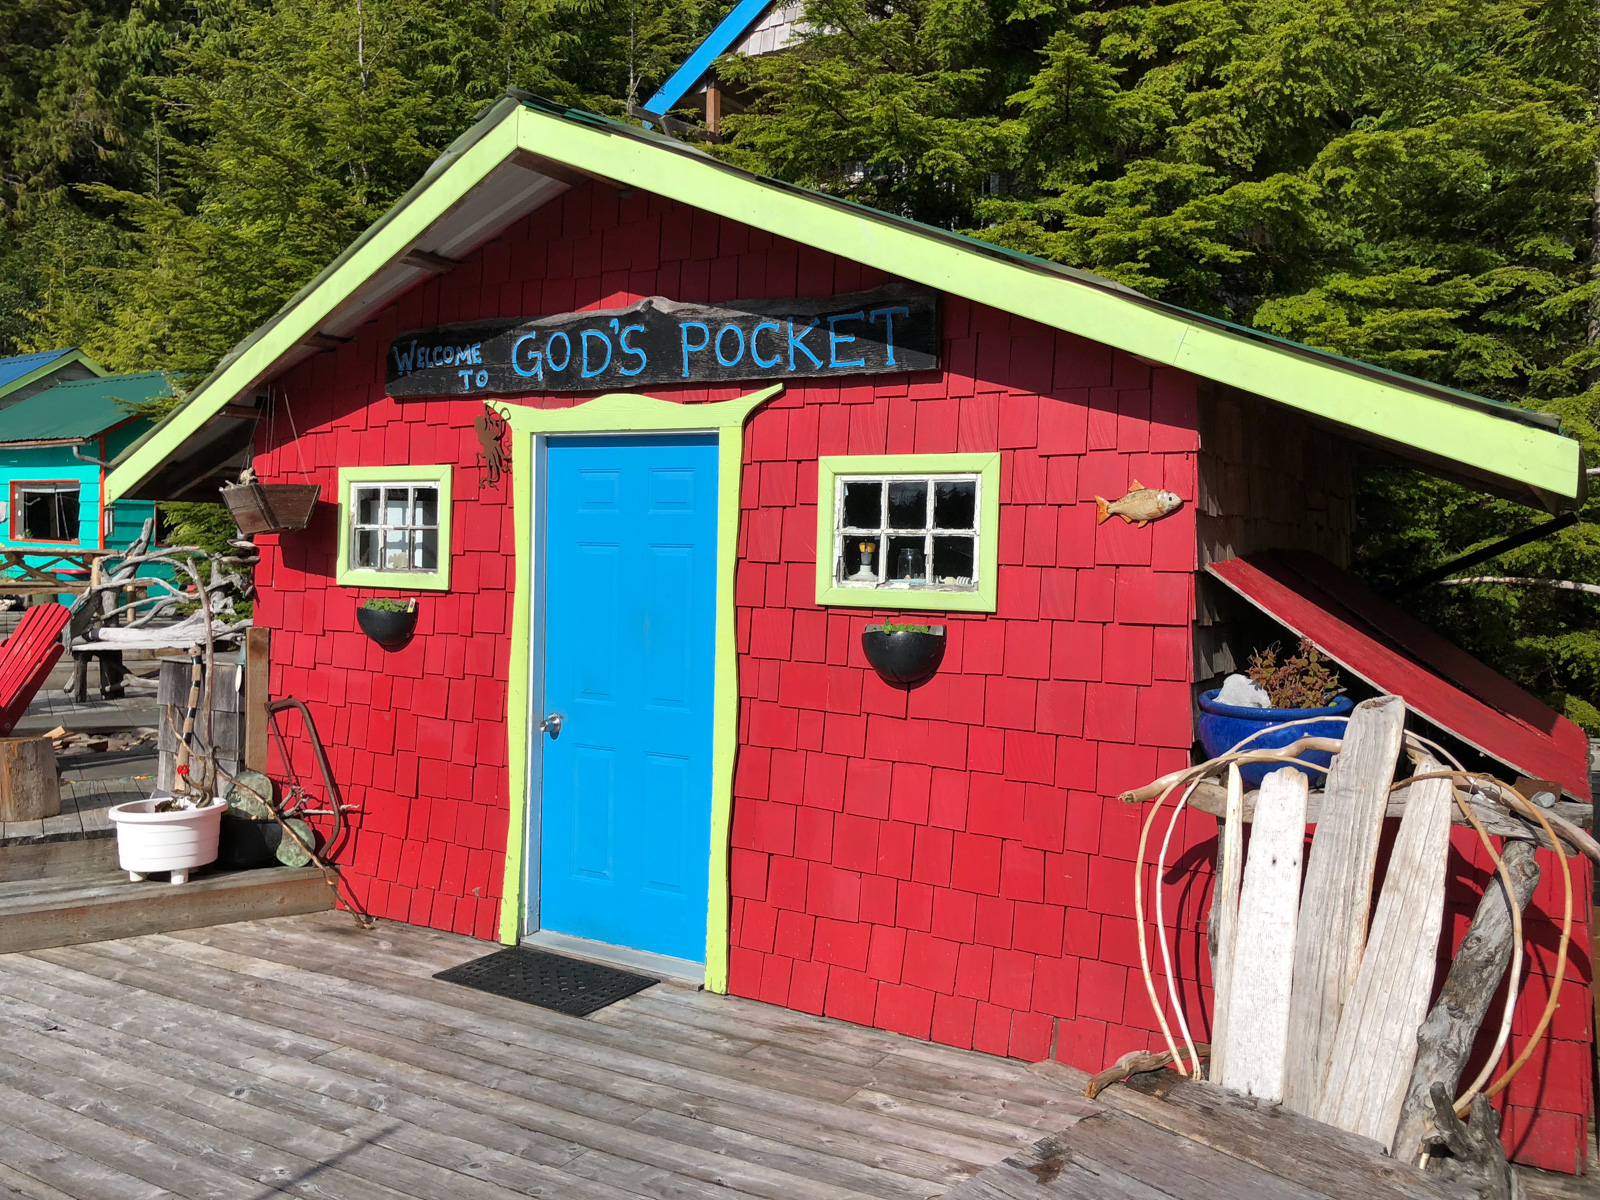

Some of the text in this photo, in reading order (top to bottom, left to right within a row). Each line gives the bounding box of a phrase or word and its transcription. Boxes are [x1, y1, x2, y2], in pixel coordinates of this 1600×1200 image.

[393, 340, 482, 375] WELCOME
[511, 306, 909, 382] GOD'S POCKET
[458, 370, 489, 390] TO
